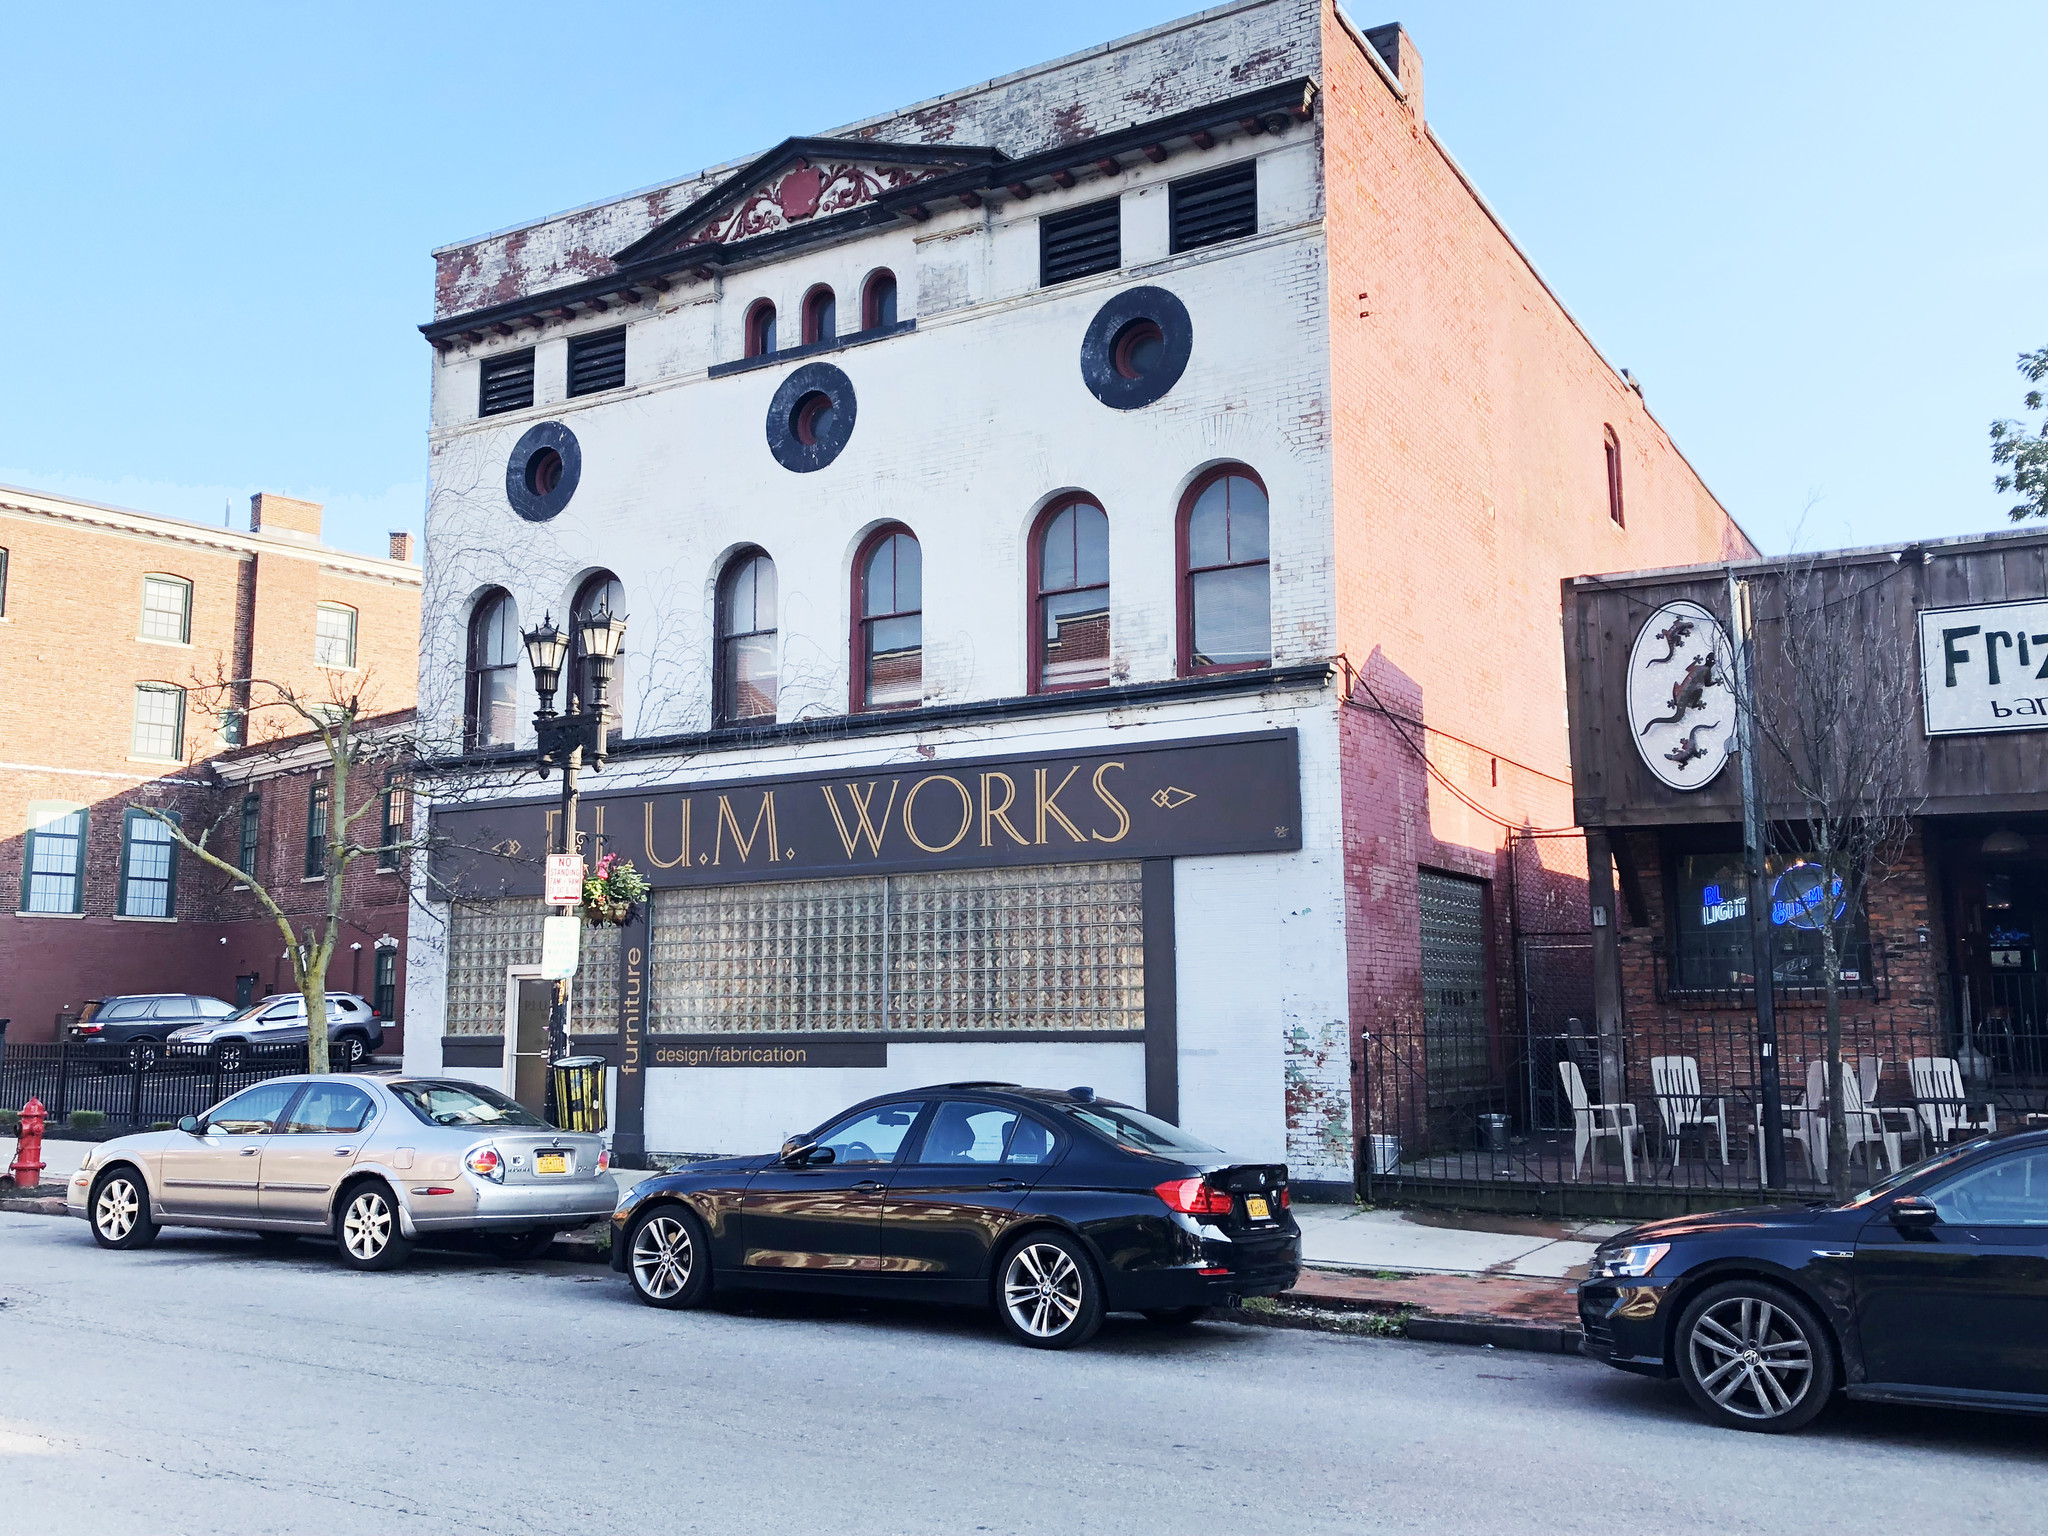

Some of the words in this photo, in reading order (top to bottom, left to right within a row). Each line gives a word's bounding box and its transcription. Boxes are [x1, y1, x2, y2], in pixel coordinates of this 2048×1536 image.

[820, 761, 1131, 860] WORKS
[550, 868, 579, 877] STANDING
[559, 858, 571, 867] NO
[550, 877, 561, 885] 7AM
[1703, 897, 1747, 926] LIGHT
[621, 947, 642, 1076] furniture
[655, 1046, 807, 1066] design/fabrication
